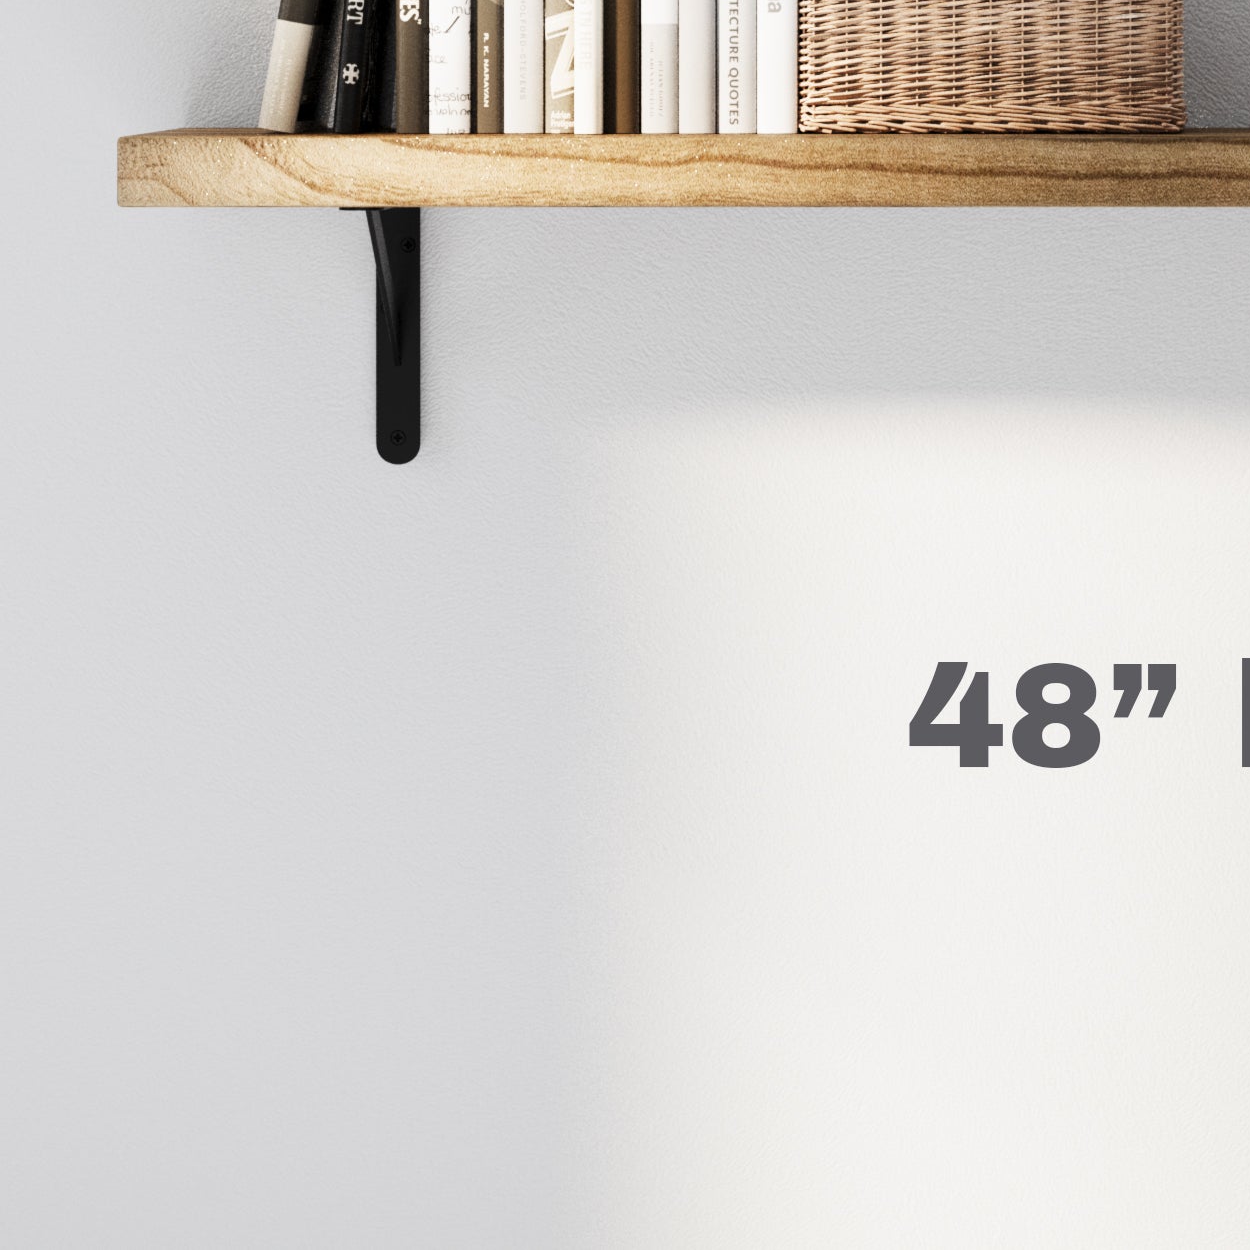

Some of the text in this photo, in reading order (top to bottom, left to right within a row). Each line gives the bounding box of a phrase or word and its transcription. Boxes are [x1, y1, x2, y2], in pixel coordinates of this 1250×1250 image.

[578, 10, 592, 27] IN
[482, 32, 490, 108] R. K. NARAYAN
[578, 31, 592, 70] HERE
[729, 67, 740, 126] QUOTES
